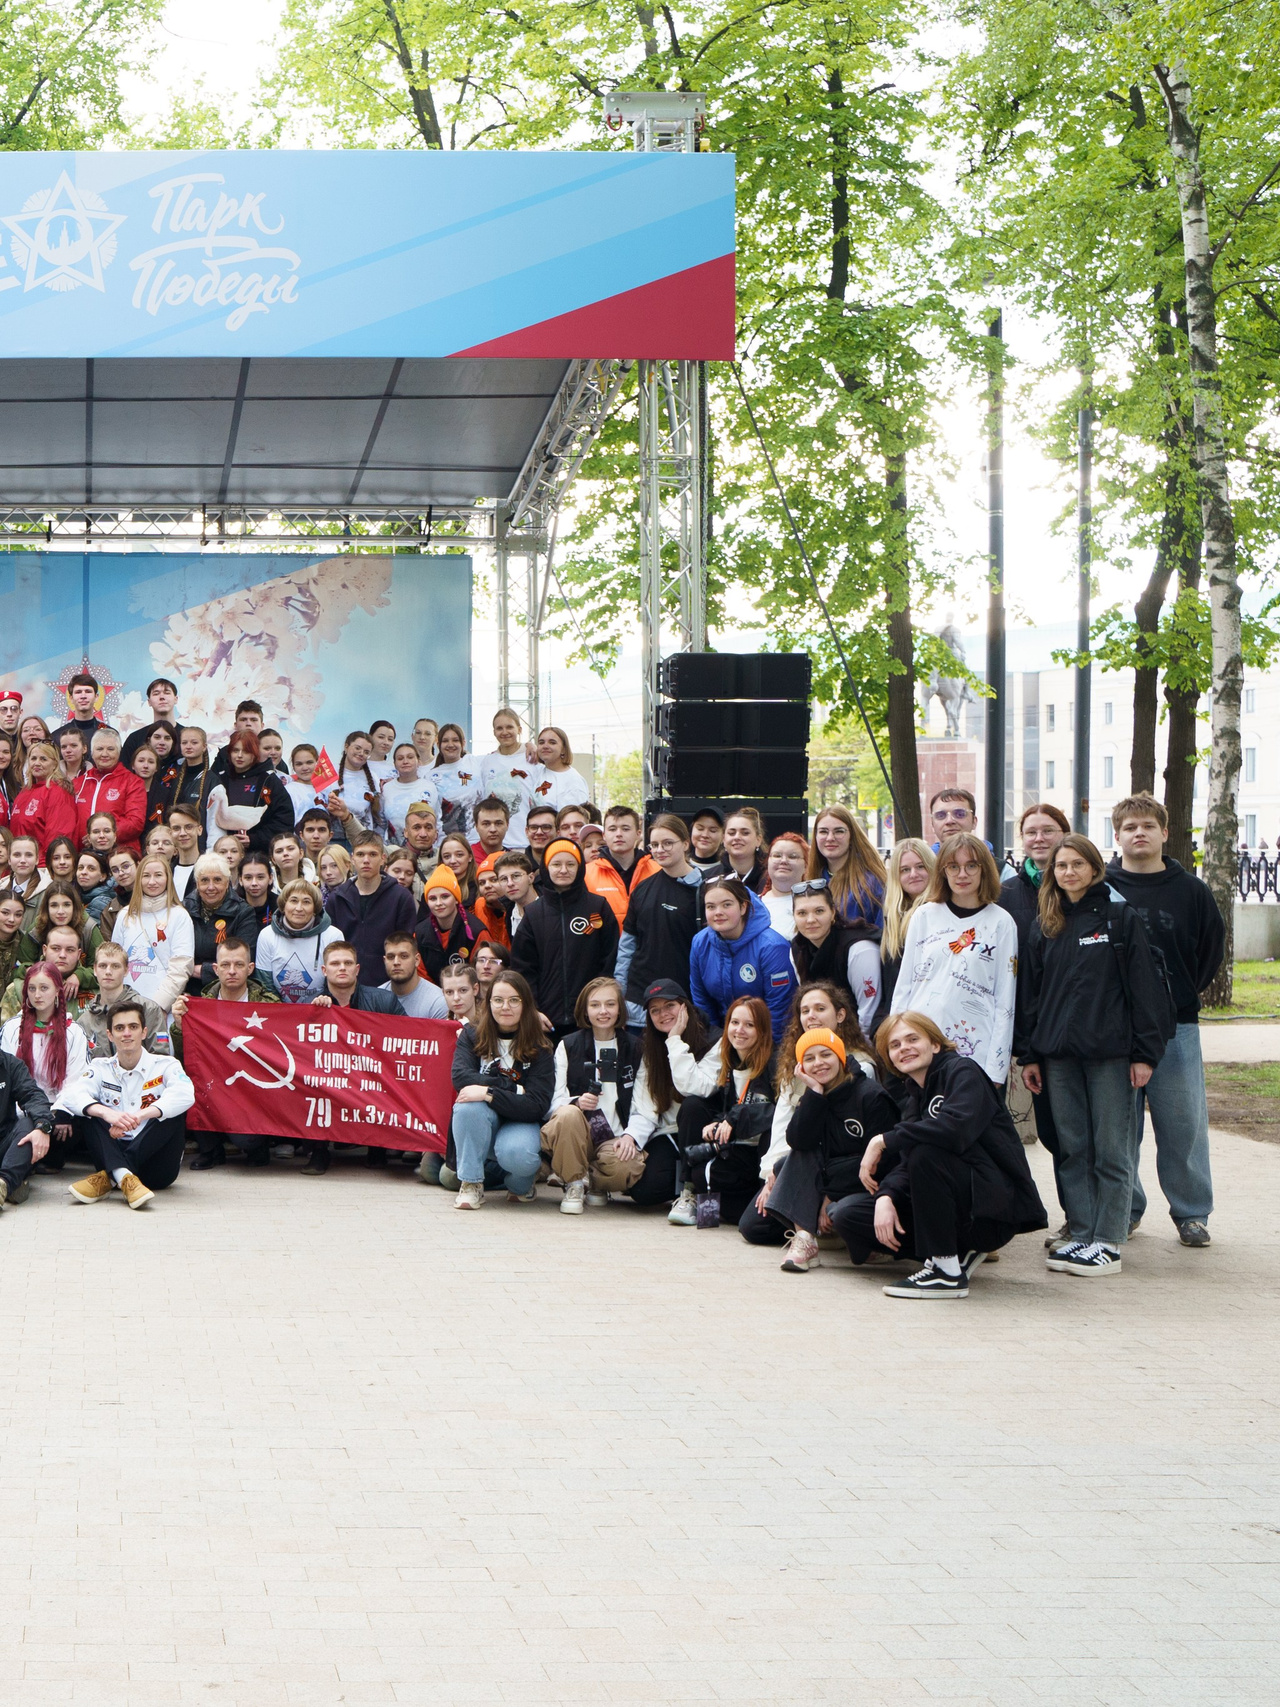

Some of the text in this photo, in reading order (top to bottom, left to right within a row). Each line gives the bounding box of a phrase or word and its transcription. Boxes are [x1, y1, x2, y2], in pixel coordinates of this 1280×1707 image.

[148, 172, 285, 242] Парк
[129, 236, 301, 332] Победы
[296, 1023, 338, 1042] 150
[382, 1036, 439, 1056] ОРДЕНА
[305, 1097, 331, 1127] 79
